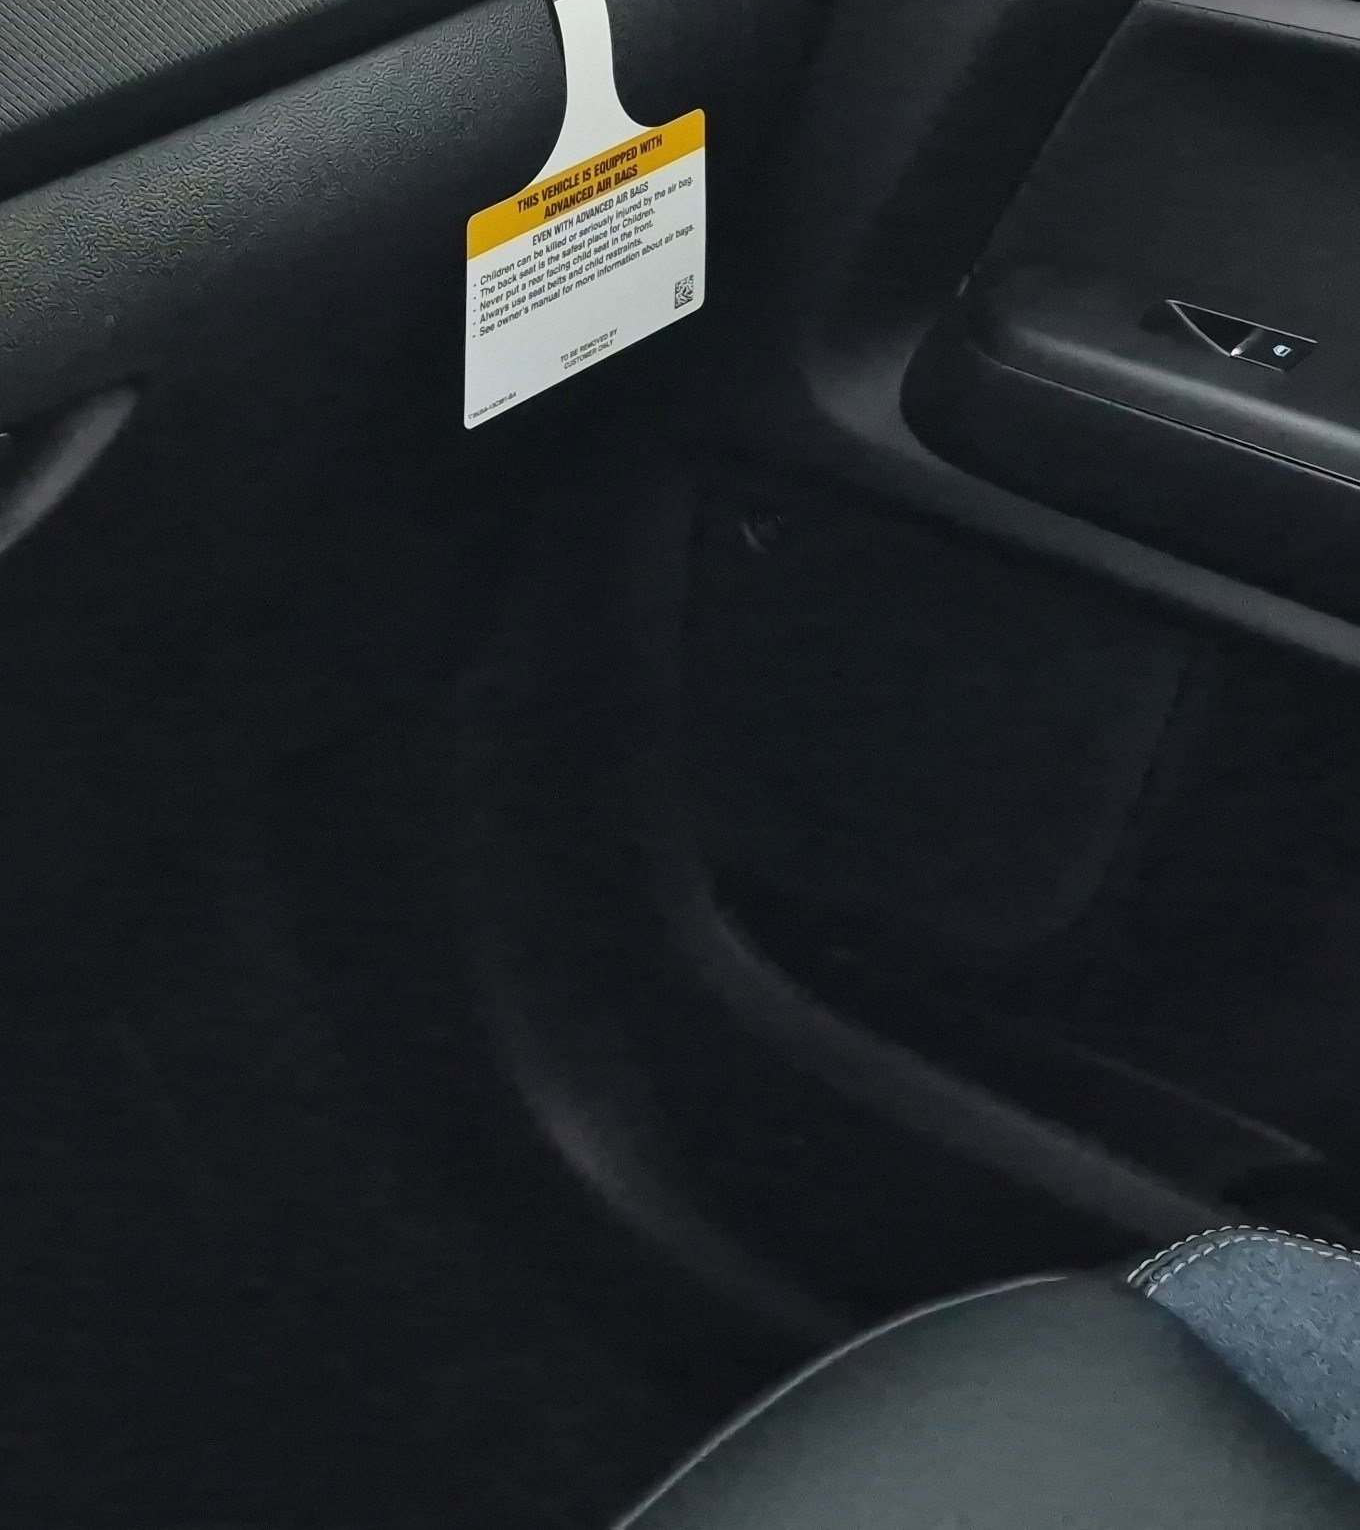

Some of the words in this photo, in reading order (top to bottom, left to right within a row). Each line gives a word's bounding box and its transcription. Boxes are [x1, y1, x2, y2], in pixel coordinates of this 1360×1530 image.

[517, 193, 539, 213] THIS
[542, 173, 579, 201] VEHICLE
[582, 167, 591, 183] IS
[594, 146, 638, 177] EQUIPPED
[640, 134, 663, 154] WITH
[532, 227, 552, 246] EVEN
[554, 217, 574, 235] WITH
[575, 199, 614, 225] ADVANCED
[616, 191, 628, 209] AIR
[629, 181, 649, 199] BAGS
[544, 185, 594, 220] ADVANCED
[596, 176, 612, 195] AIR
[614, 164, 637, 186] BAGS
[479, 293, 504, 312] Never
[505, 283, 520, 301] put
[521, 282, 527, 291] a
[528, 272, 545, 288] rear
[546, 260, 571, 279] facing
[572, 250, 592, 266] child
[593, 240, 610, 256] seat
[611, 235, 619, 246] in
[620, 230, 633, 242] the
[634, 219, 654, 235] front.
[480, 263, 515, 286] Children
[516, 255, 532, 268] can
[533, 247, 544, 260] be
[545, 236, 567, 253] killed
[568, 232, 577, 242] or
[579, 214, 614, 238] seriously
[615, 199, 642, 219] injured
[643, 195, 653, 207] by
[654, 189, 666, 201] the
[667, 183, 677, 195] air
[480, 285, 495, 298] The
[497, 273, 518, 290] back
[518, 264, 536, 280] seat
[538, 260, 546, 270] is
[547, 253, 560, 265] the
[561, 241, 585, 259] safest
[587, 230, 608, 248] place
[609, 223, 621, 235] for
[622, 207, 656, 229] Children.
[479, 303, 510, 325] Always
[511, 295, 527, 309] use
[528, 284, 546, 300] seat
[547, 274, 567, 291] belts
[568, 265, 584, 280] and
[584, 255, 604, 272] child
[605, 237, 643, 262] restraints.
[479, 323, 495, 337] See
[496, 306, 529, 328] owner's
[530, 288, 561, 311] manual
[562, 281, 573, 296] for
[575, 272, 596, 289] more
[597, 250, 640, 278] information
[641, 238, 663, 256] about
[664, 233, 674, 245] air
[561, 353, 569, 363] TO
[570, 348, 578, 359] BE
[580, 333, 609, 352] REMOVED
[564, 347, 597, 370] CUSTOMER
